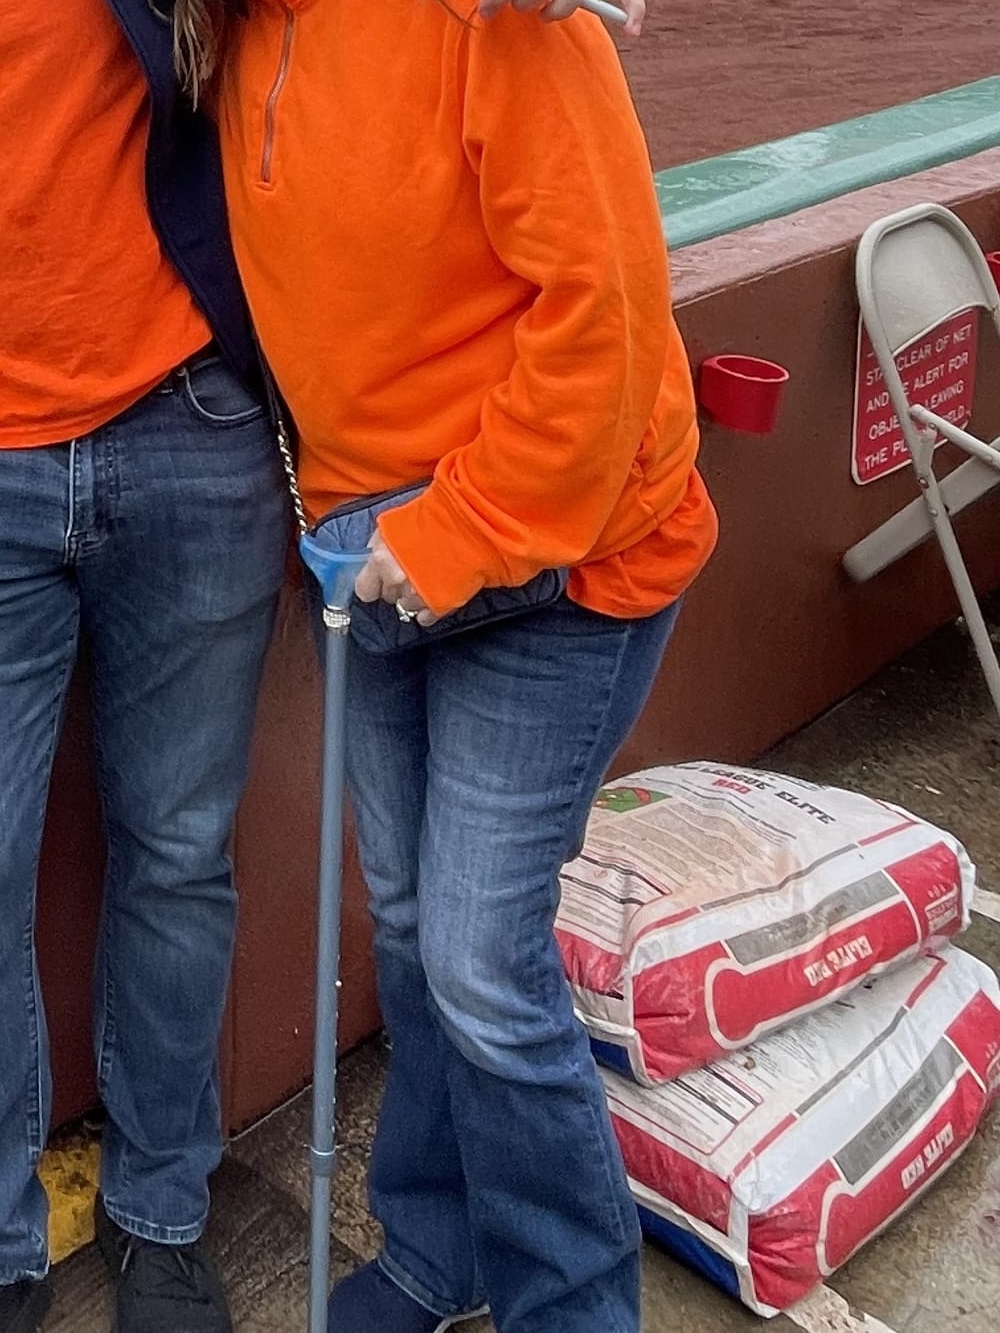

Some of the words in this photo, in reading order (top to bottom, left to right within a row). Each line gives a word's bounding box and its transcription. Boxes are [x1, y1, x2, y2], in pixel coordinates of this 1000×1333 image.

[866, 366, 885, 386] STA
[896, 344, 932, 372] CLEAR
[935, 335, 951, 353] OF
[952, 323, 973, 344] NET
[866, 390, 890, 414] AND
[913, 363, 945, 391] ALERT
[947, 352, 970, 374] FOR
[868, 414, 900, 442] OBJE
[924, 379, 966, 412] LEAVING
[863, 446, 889, 471] THE
[712, 778, 752, 795] RED
[774, 791, 837, 825] ELITE
[826, 935, 874, 971] ELITE
